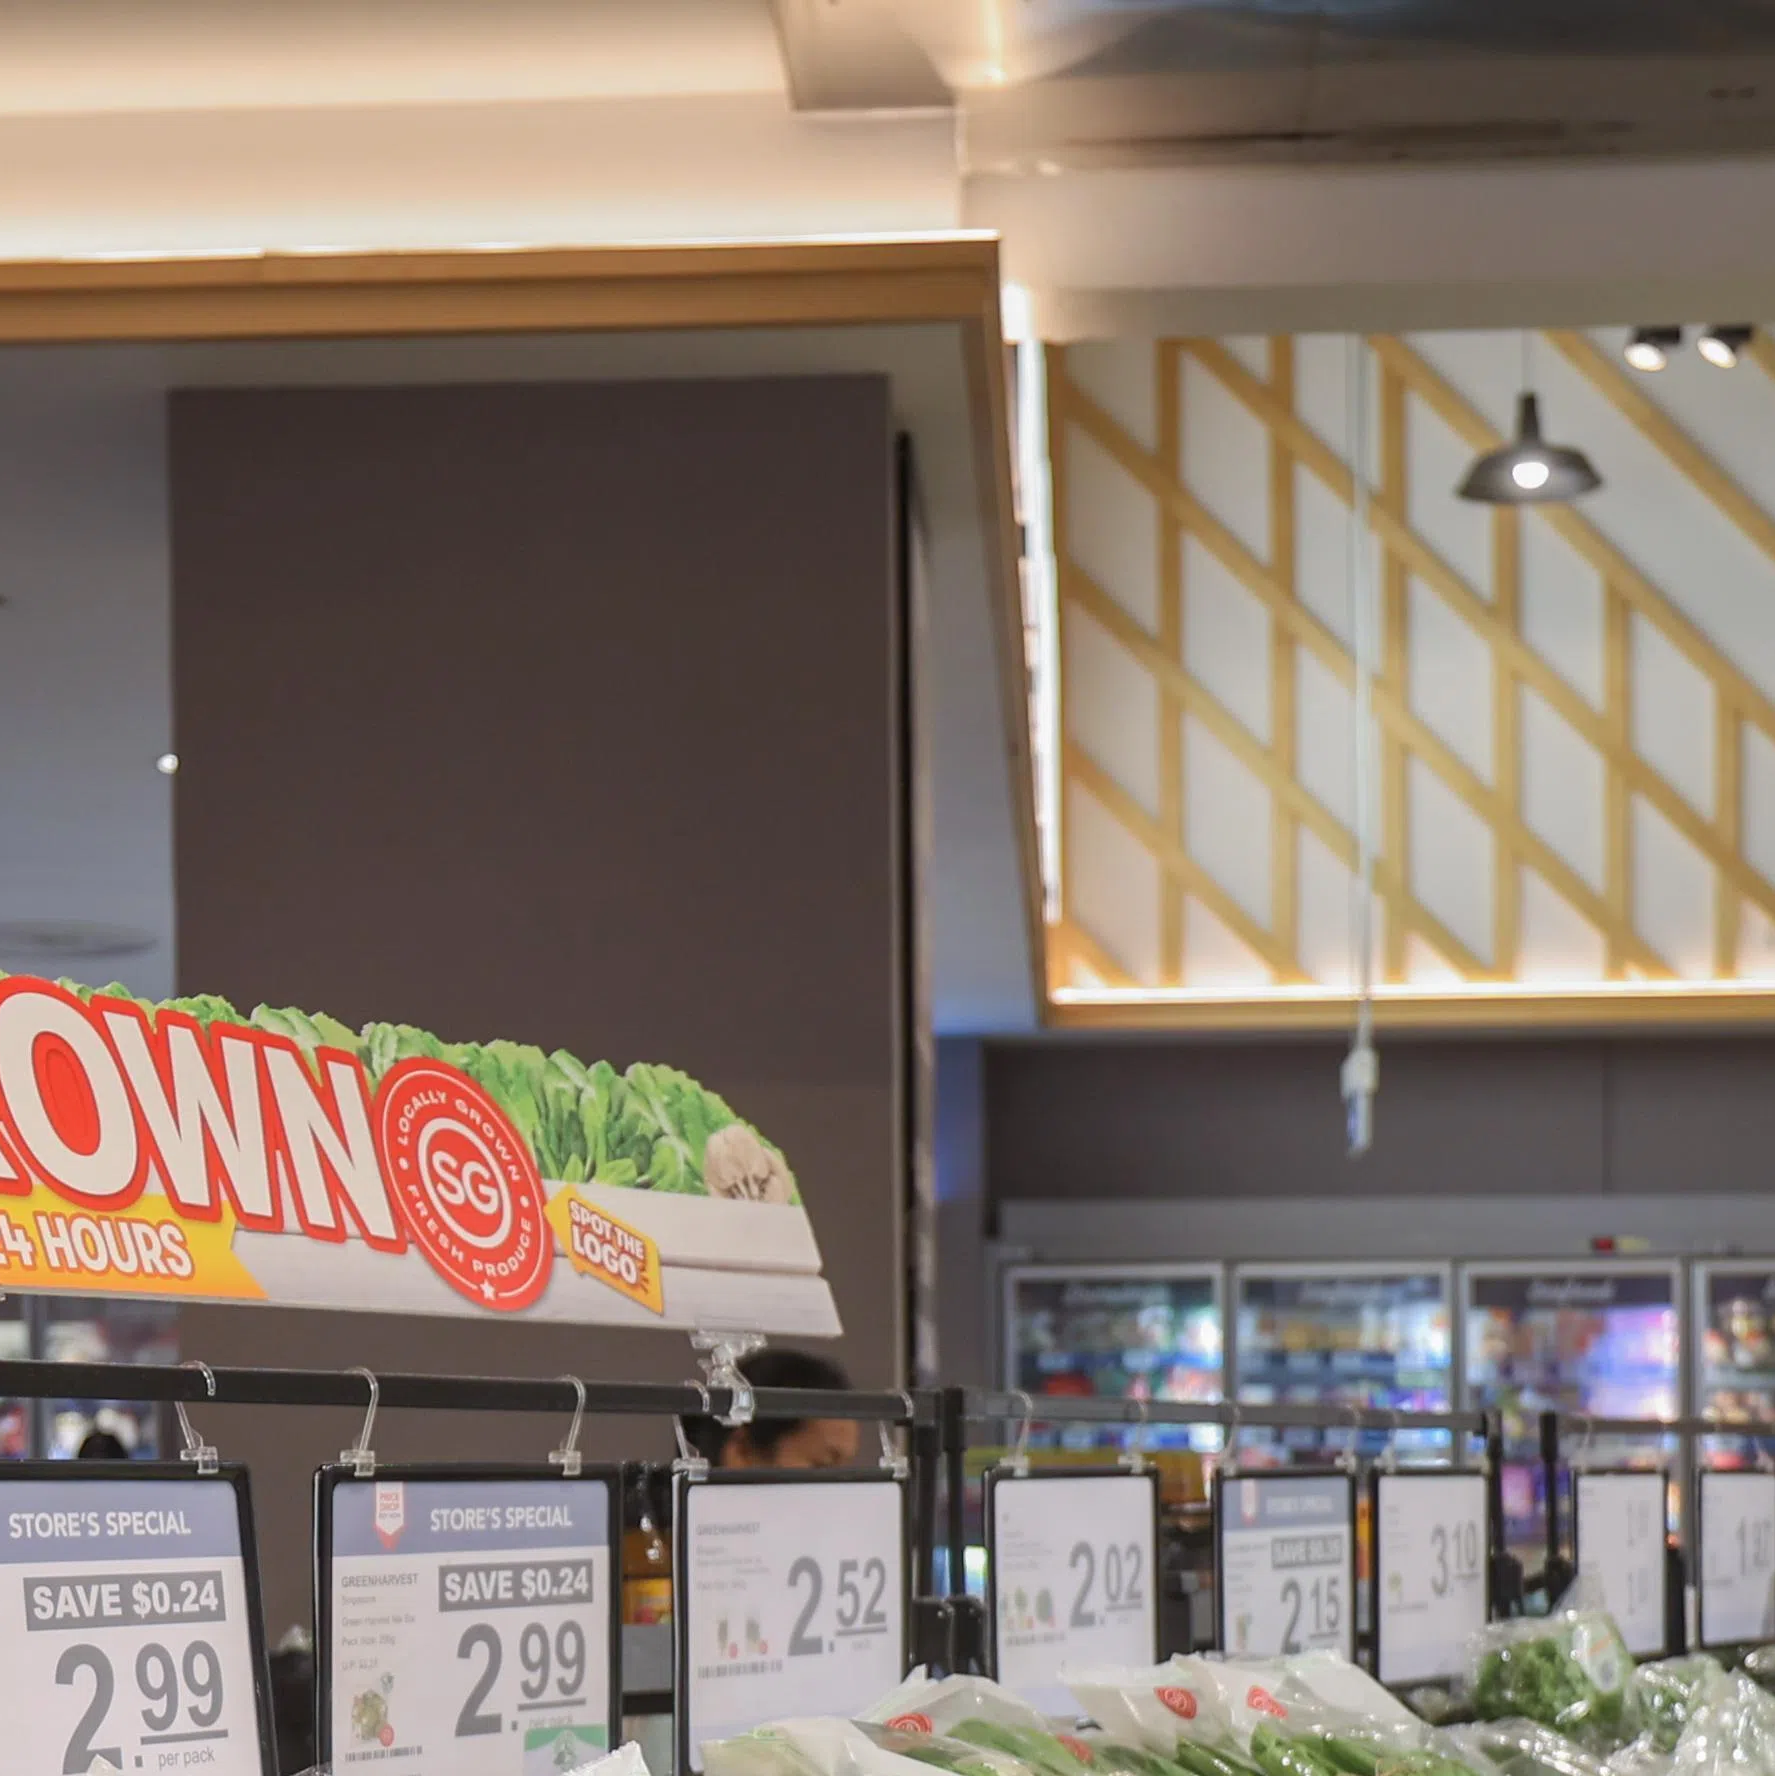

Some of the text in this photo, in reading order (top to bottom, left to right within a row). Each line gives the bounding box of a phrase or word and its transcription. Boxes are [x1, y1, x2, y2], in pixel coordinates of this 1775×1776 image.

[397, 1089, 521, 1181] LOCALLY GROWN
[431, 1150, 500, 1215] SG
[43, 1213, 192, 1279] HOURS
[406, 1184, 533, 1278] FRESH PRODUCE
[569, 1198, 645, 1261] SPOT THE
[571, 1224, 638, 1286] LOGO
[9, 1510, 192, 1540] STORE'S SPECIAL
[430, 1505, 572, 1532] STORE'S SPECIAL
[33, 1578, 219, 1622] SAVE $0.24
[341, 1573, 418, 1588] GREENHARVEST
[444, 1565, 590, 1603] SAVE $0.24
[158, 1747, 215, 1769] per pack
